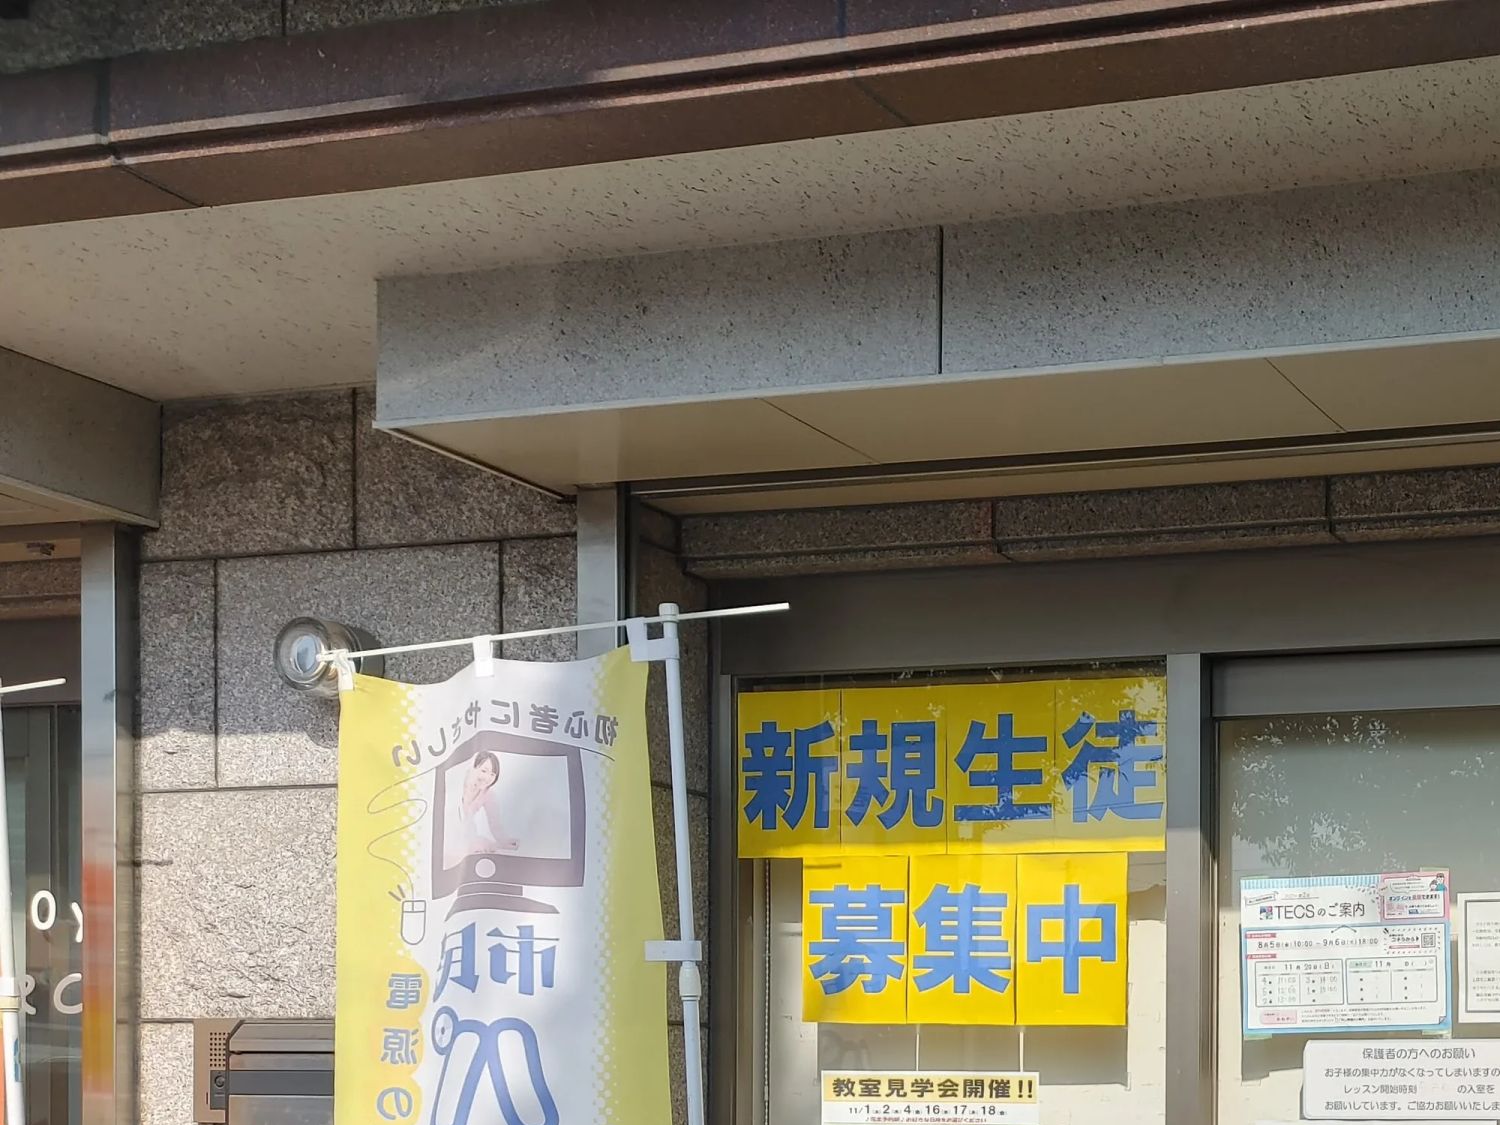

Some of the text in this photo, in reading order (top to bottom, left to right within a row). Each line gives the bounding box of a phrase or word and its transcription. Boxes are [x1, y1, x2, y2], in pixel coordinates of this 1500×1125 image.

[742, 710, 1165, 831] 新規生徒
[1275, 902, 1365, 920] TECSのご案内
[809, 883, 1118, 995] 募集中
[1362, 1047, 1476, 1059] 保護者の方へのお願い
[832, 1078, 1034, 1099] 教室見学会開催!!
[1344, 1084, 1496, 1094] レッスン開始時刻 の入室を
